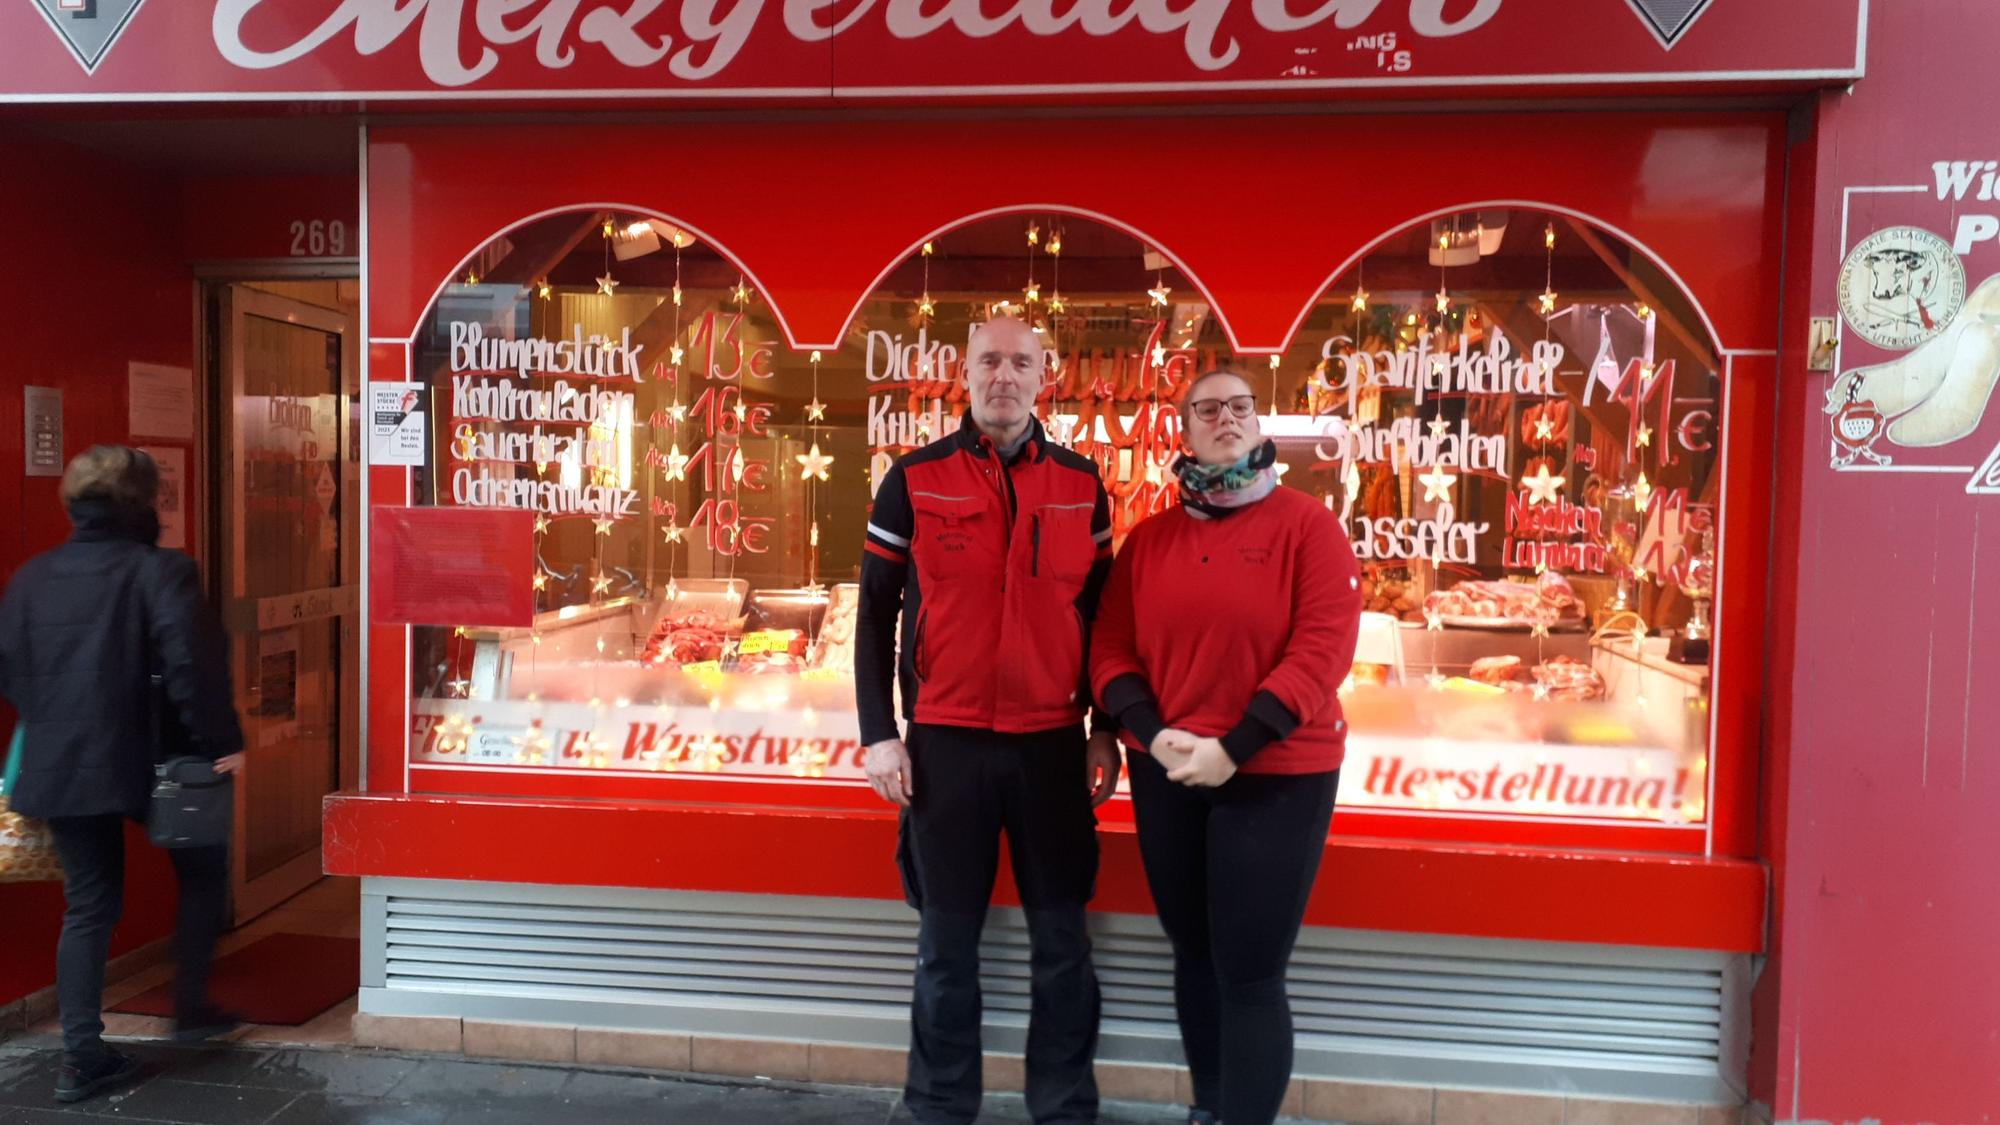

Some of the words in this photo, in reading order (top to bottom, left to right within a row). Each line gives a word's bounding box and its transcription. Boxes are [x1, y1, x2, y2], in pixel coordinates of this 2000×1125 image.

[290, 219, 345, 256] 269
[450, 320, 647, 384] Blumenstück
[865, 328, 958, 383] Dicke
[452, 374, 636, 424] Kohlrouladen
[450, 423, 620, 467] Sauerbraten
